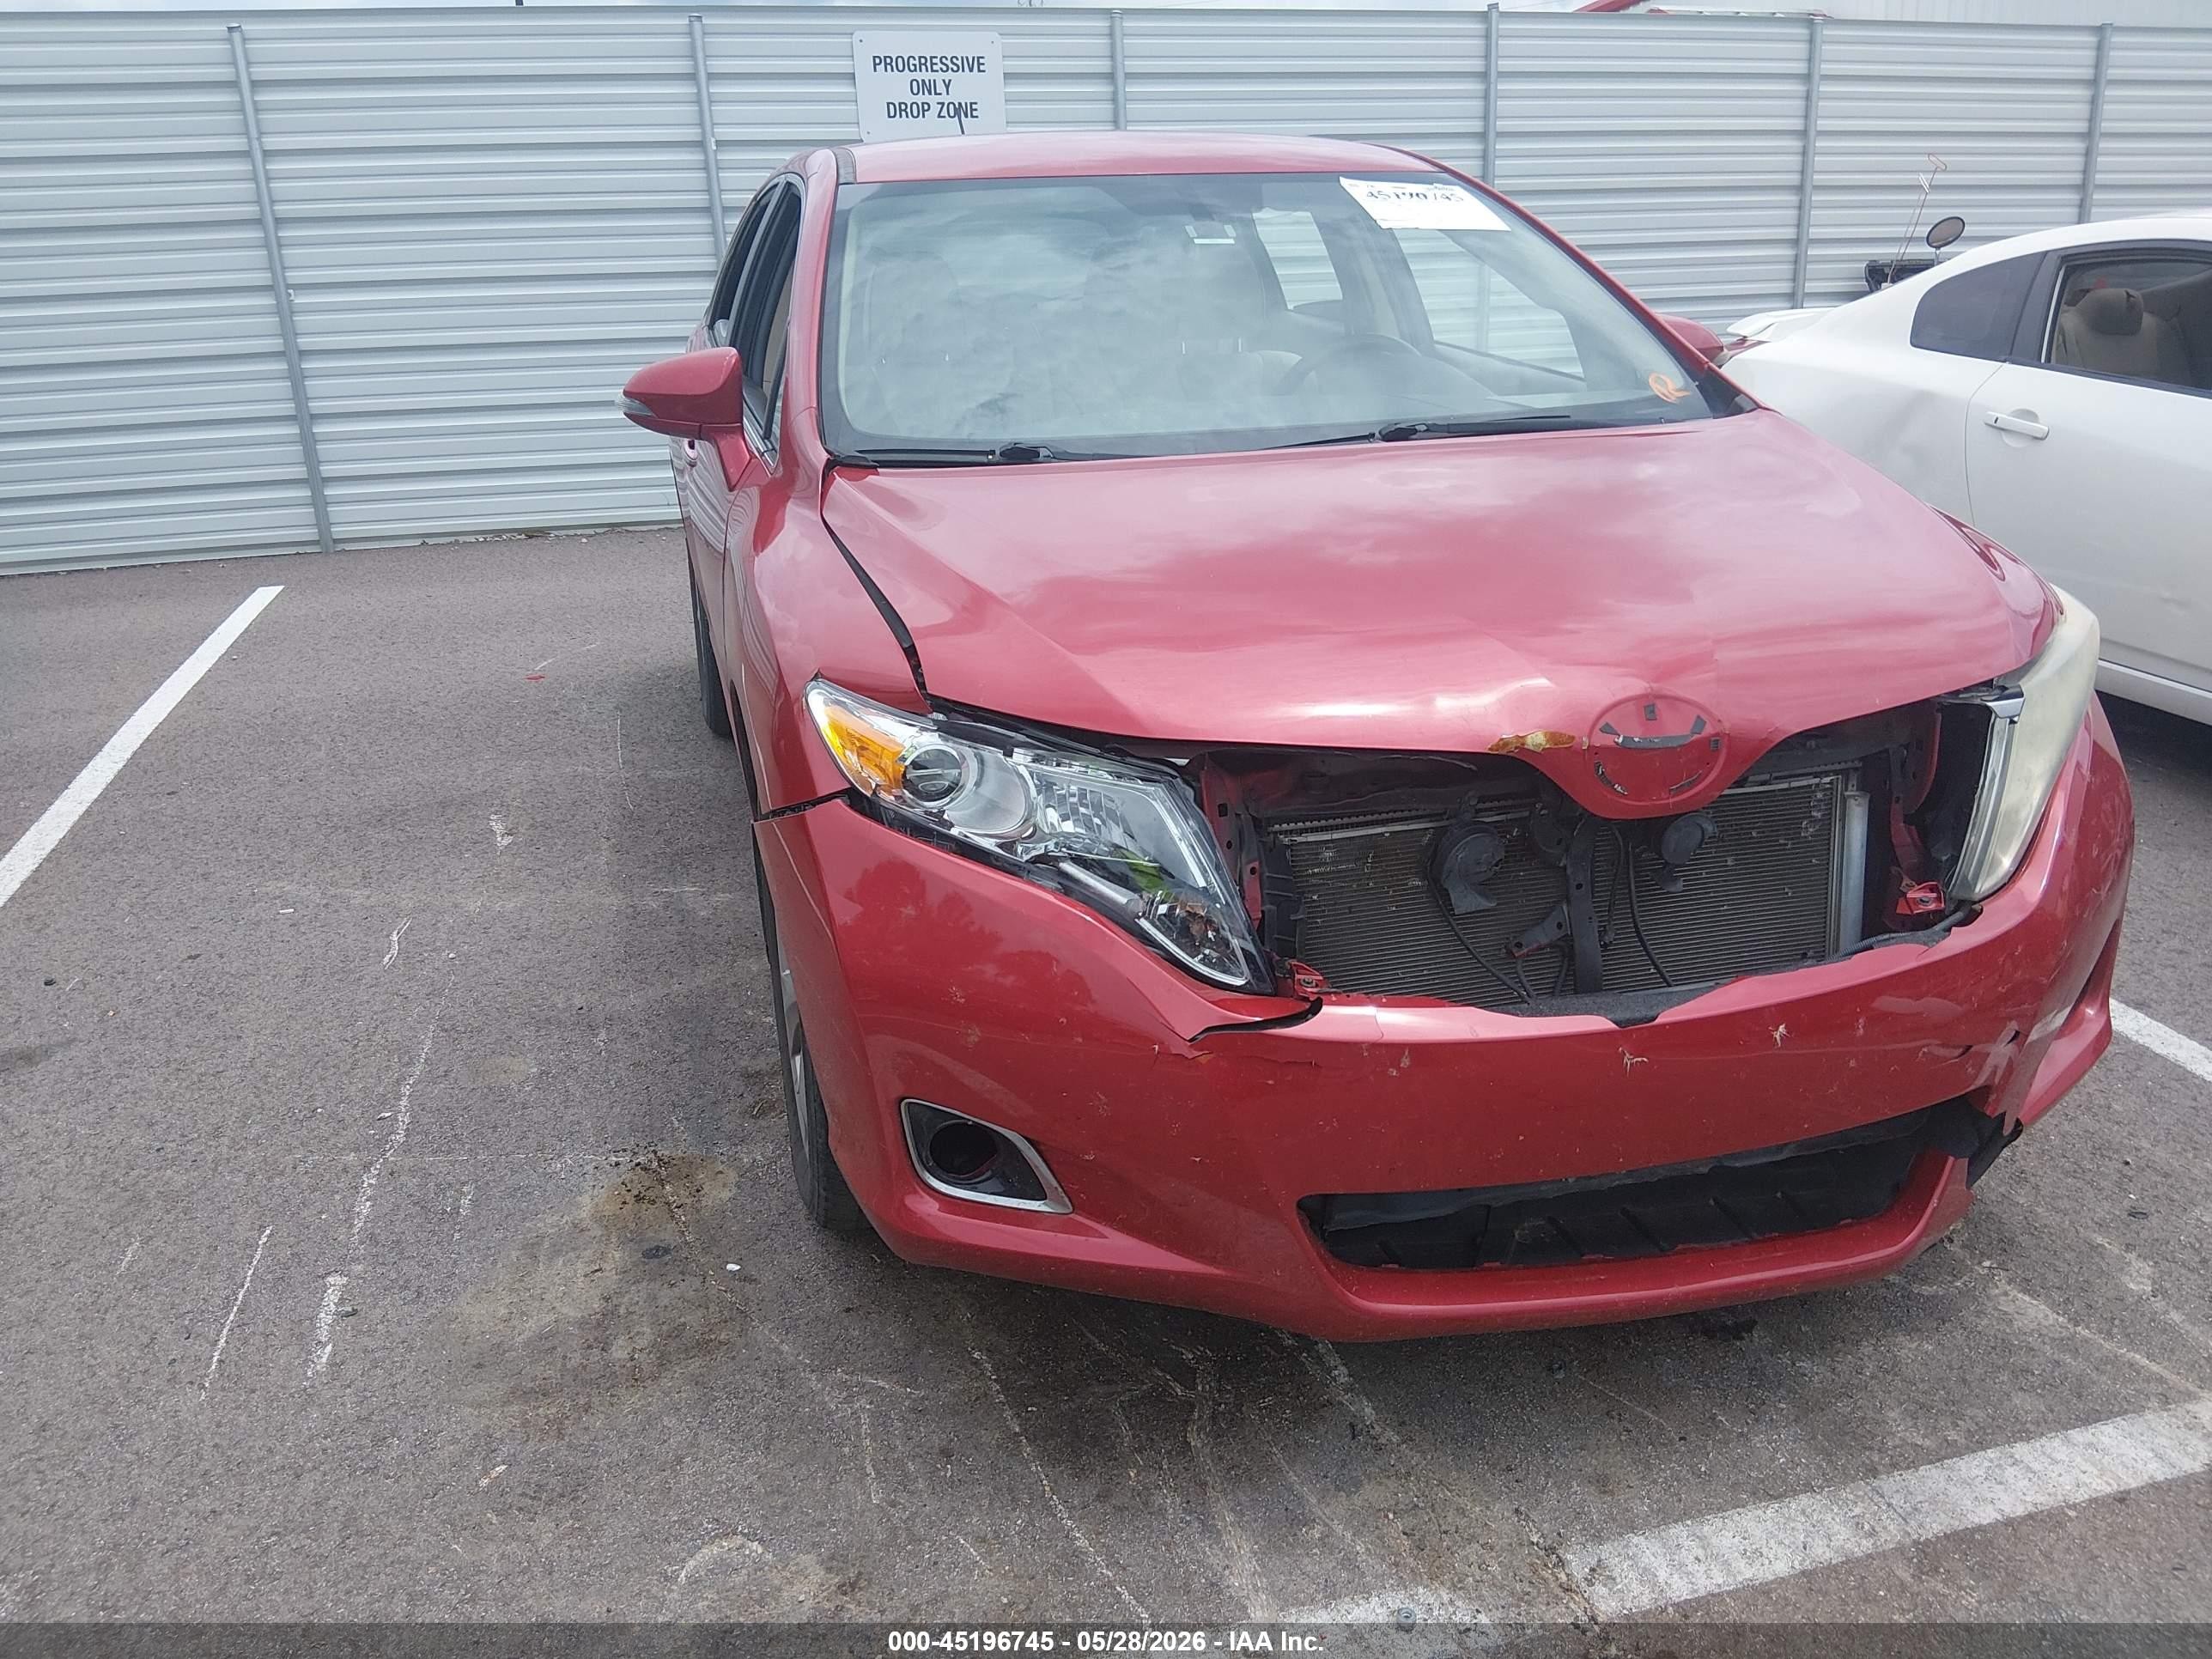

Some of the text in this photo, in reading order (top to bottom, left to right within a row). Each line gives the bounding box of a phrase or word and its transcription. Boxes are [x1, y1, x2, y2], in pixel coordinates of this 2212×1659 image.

[872, 55, 987, 74] PROGRESSIVE
[909, 78, 952, 96] ONLY
[885, 101, 979, 119] DROP ZONE
